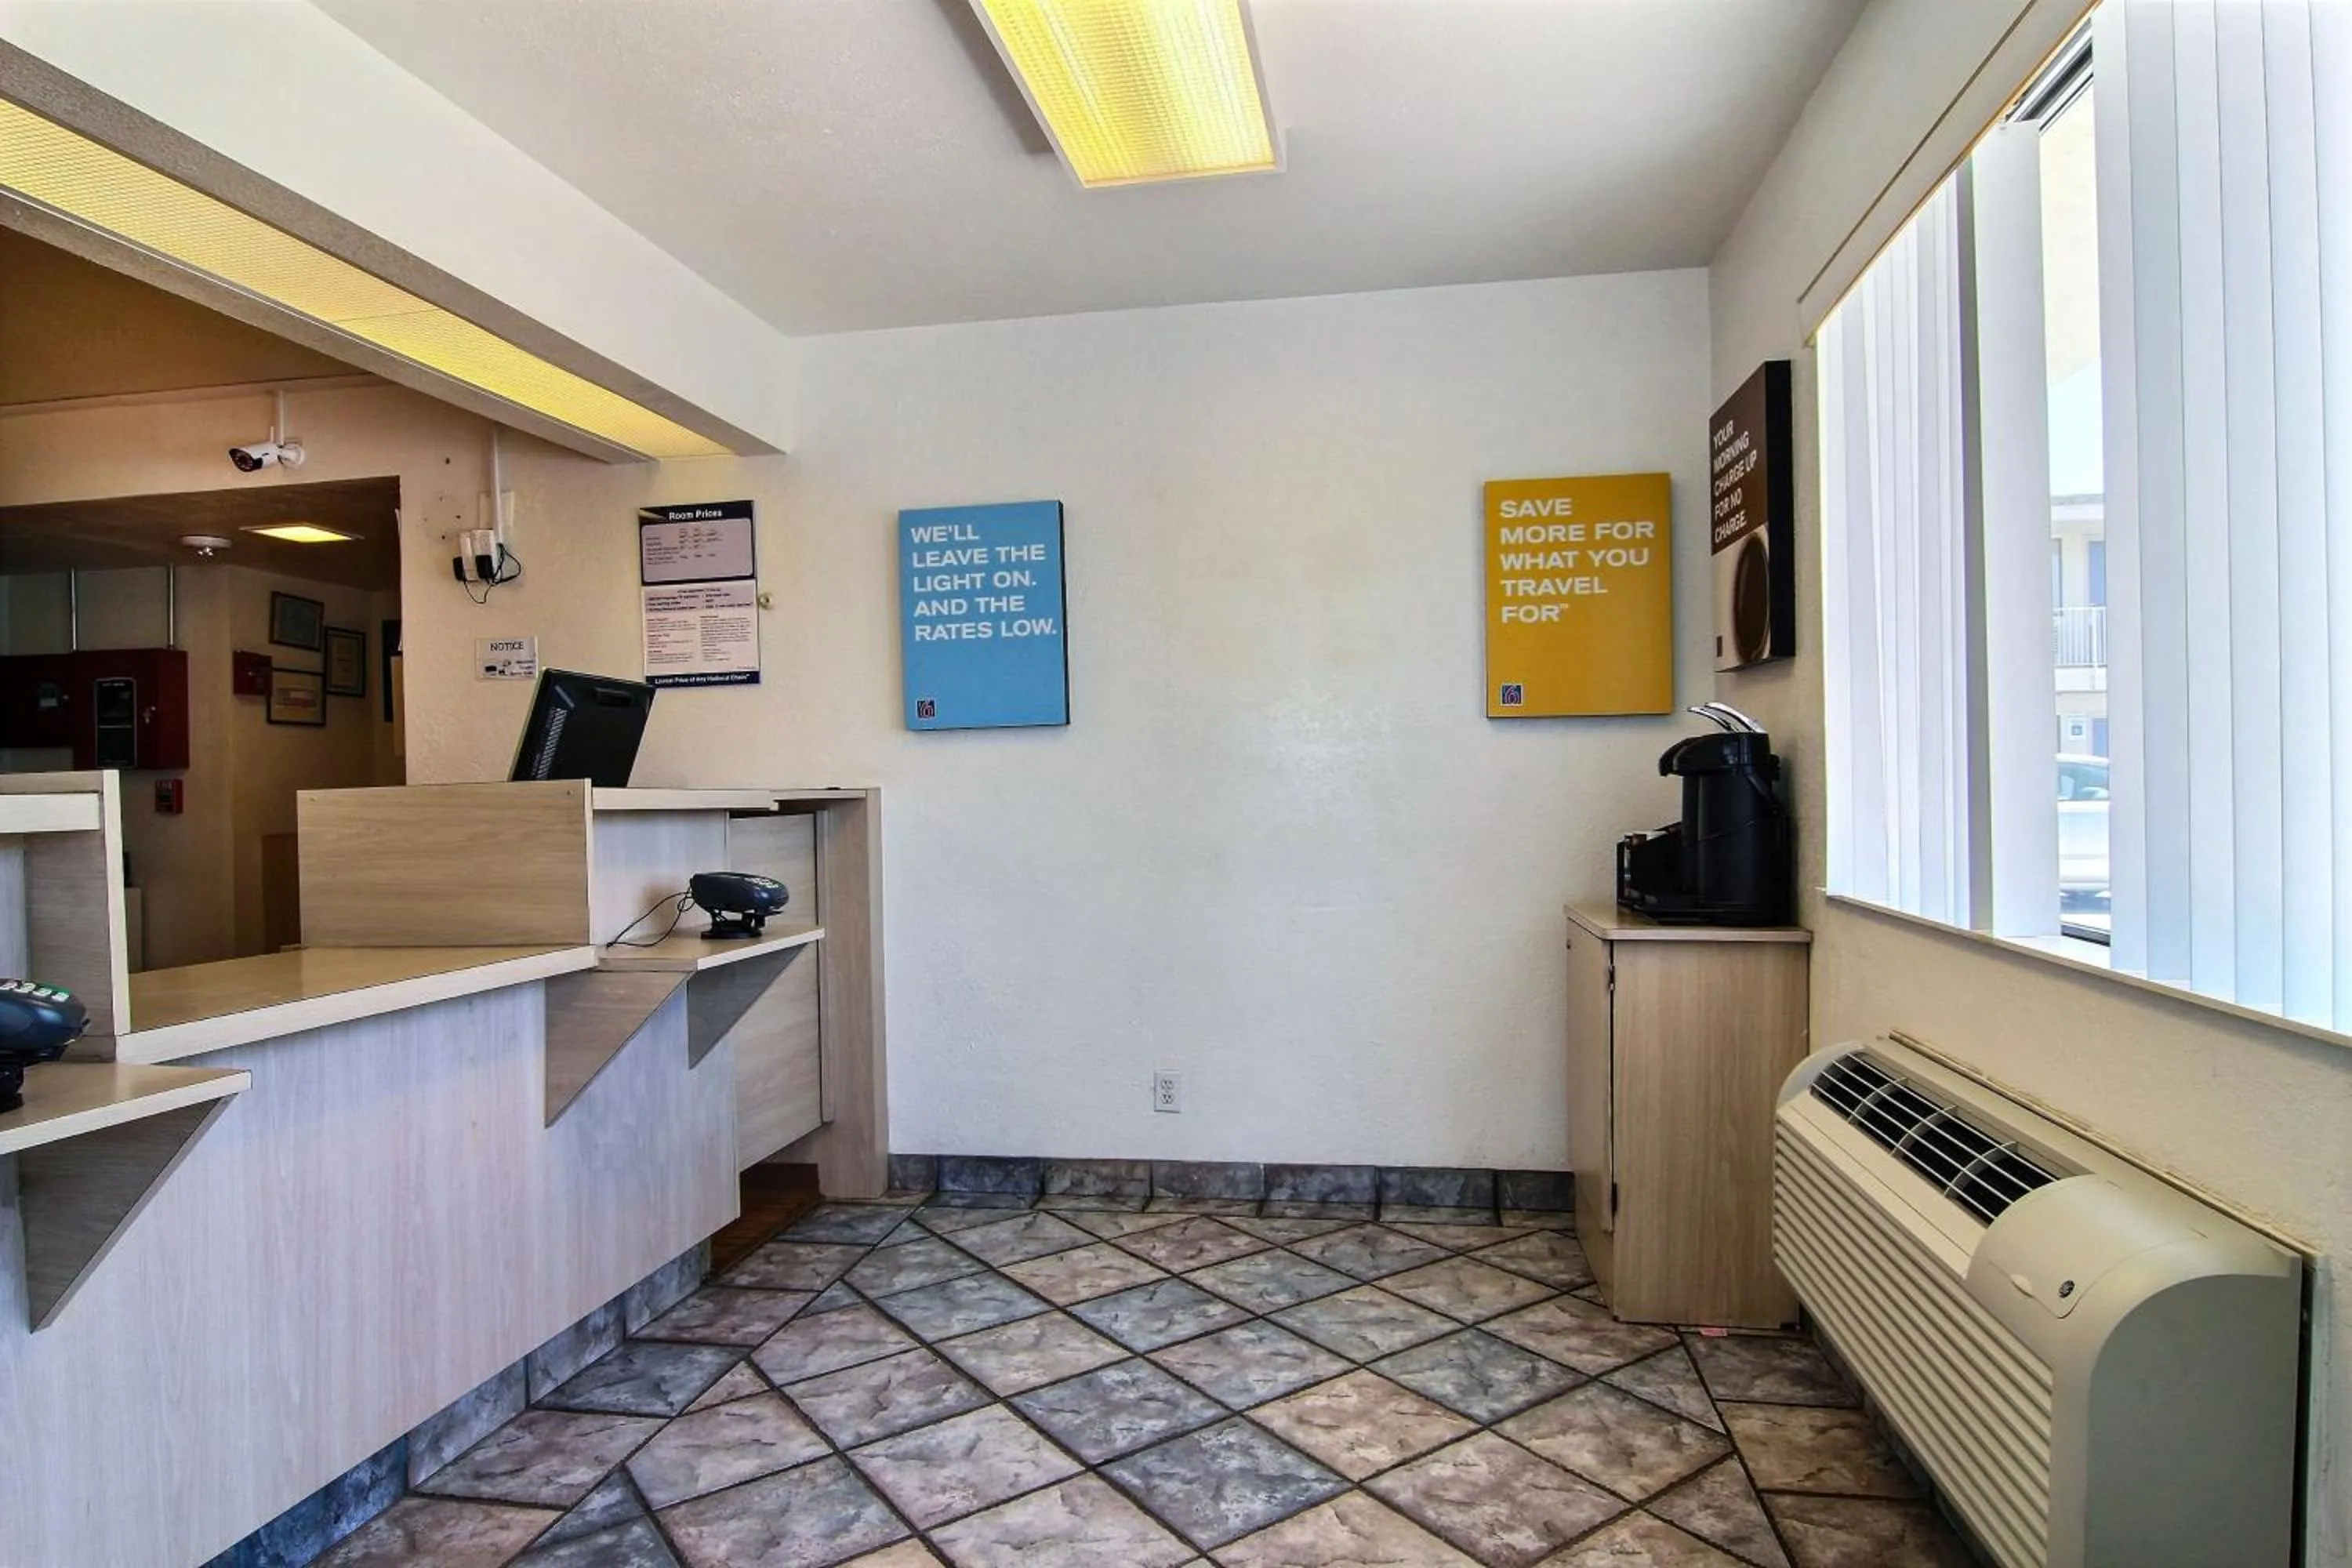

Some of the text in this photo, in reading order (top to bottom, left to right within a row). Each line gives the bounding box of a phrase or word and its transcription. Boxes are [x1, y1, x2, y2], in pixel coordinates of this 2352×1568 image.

[1713, 419, 1733, 450] YOUR
[1713, 431, 1749, 474] MORNING
[1714, 449, 1757, 497] CHARGE UP
[669, 509, 722, 521] Room Prices
[1500, 498, 1572, 518] SAVE
[1715, 488, 1742, 521] FOR NO
[911, 524, 979, 543] WE'LL
[1500, 521, 1654, 545] MORE FOR
[1715, 510, 1747, 543] CHARGE
[913, 544, 1046, 568] LEAVE THE
[1500, 547, 1650, 571] WHAT YOU
[913, 571, 1036, 593] LIGHT ON.
[1500, 576, 1608, 597] TRAVEL
[914, 595, 1025, 617] AND THE
[915, 618, 1057, 641] RATES LOW.
[490, 641, 524, 652] NOTICE
